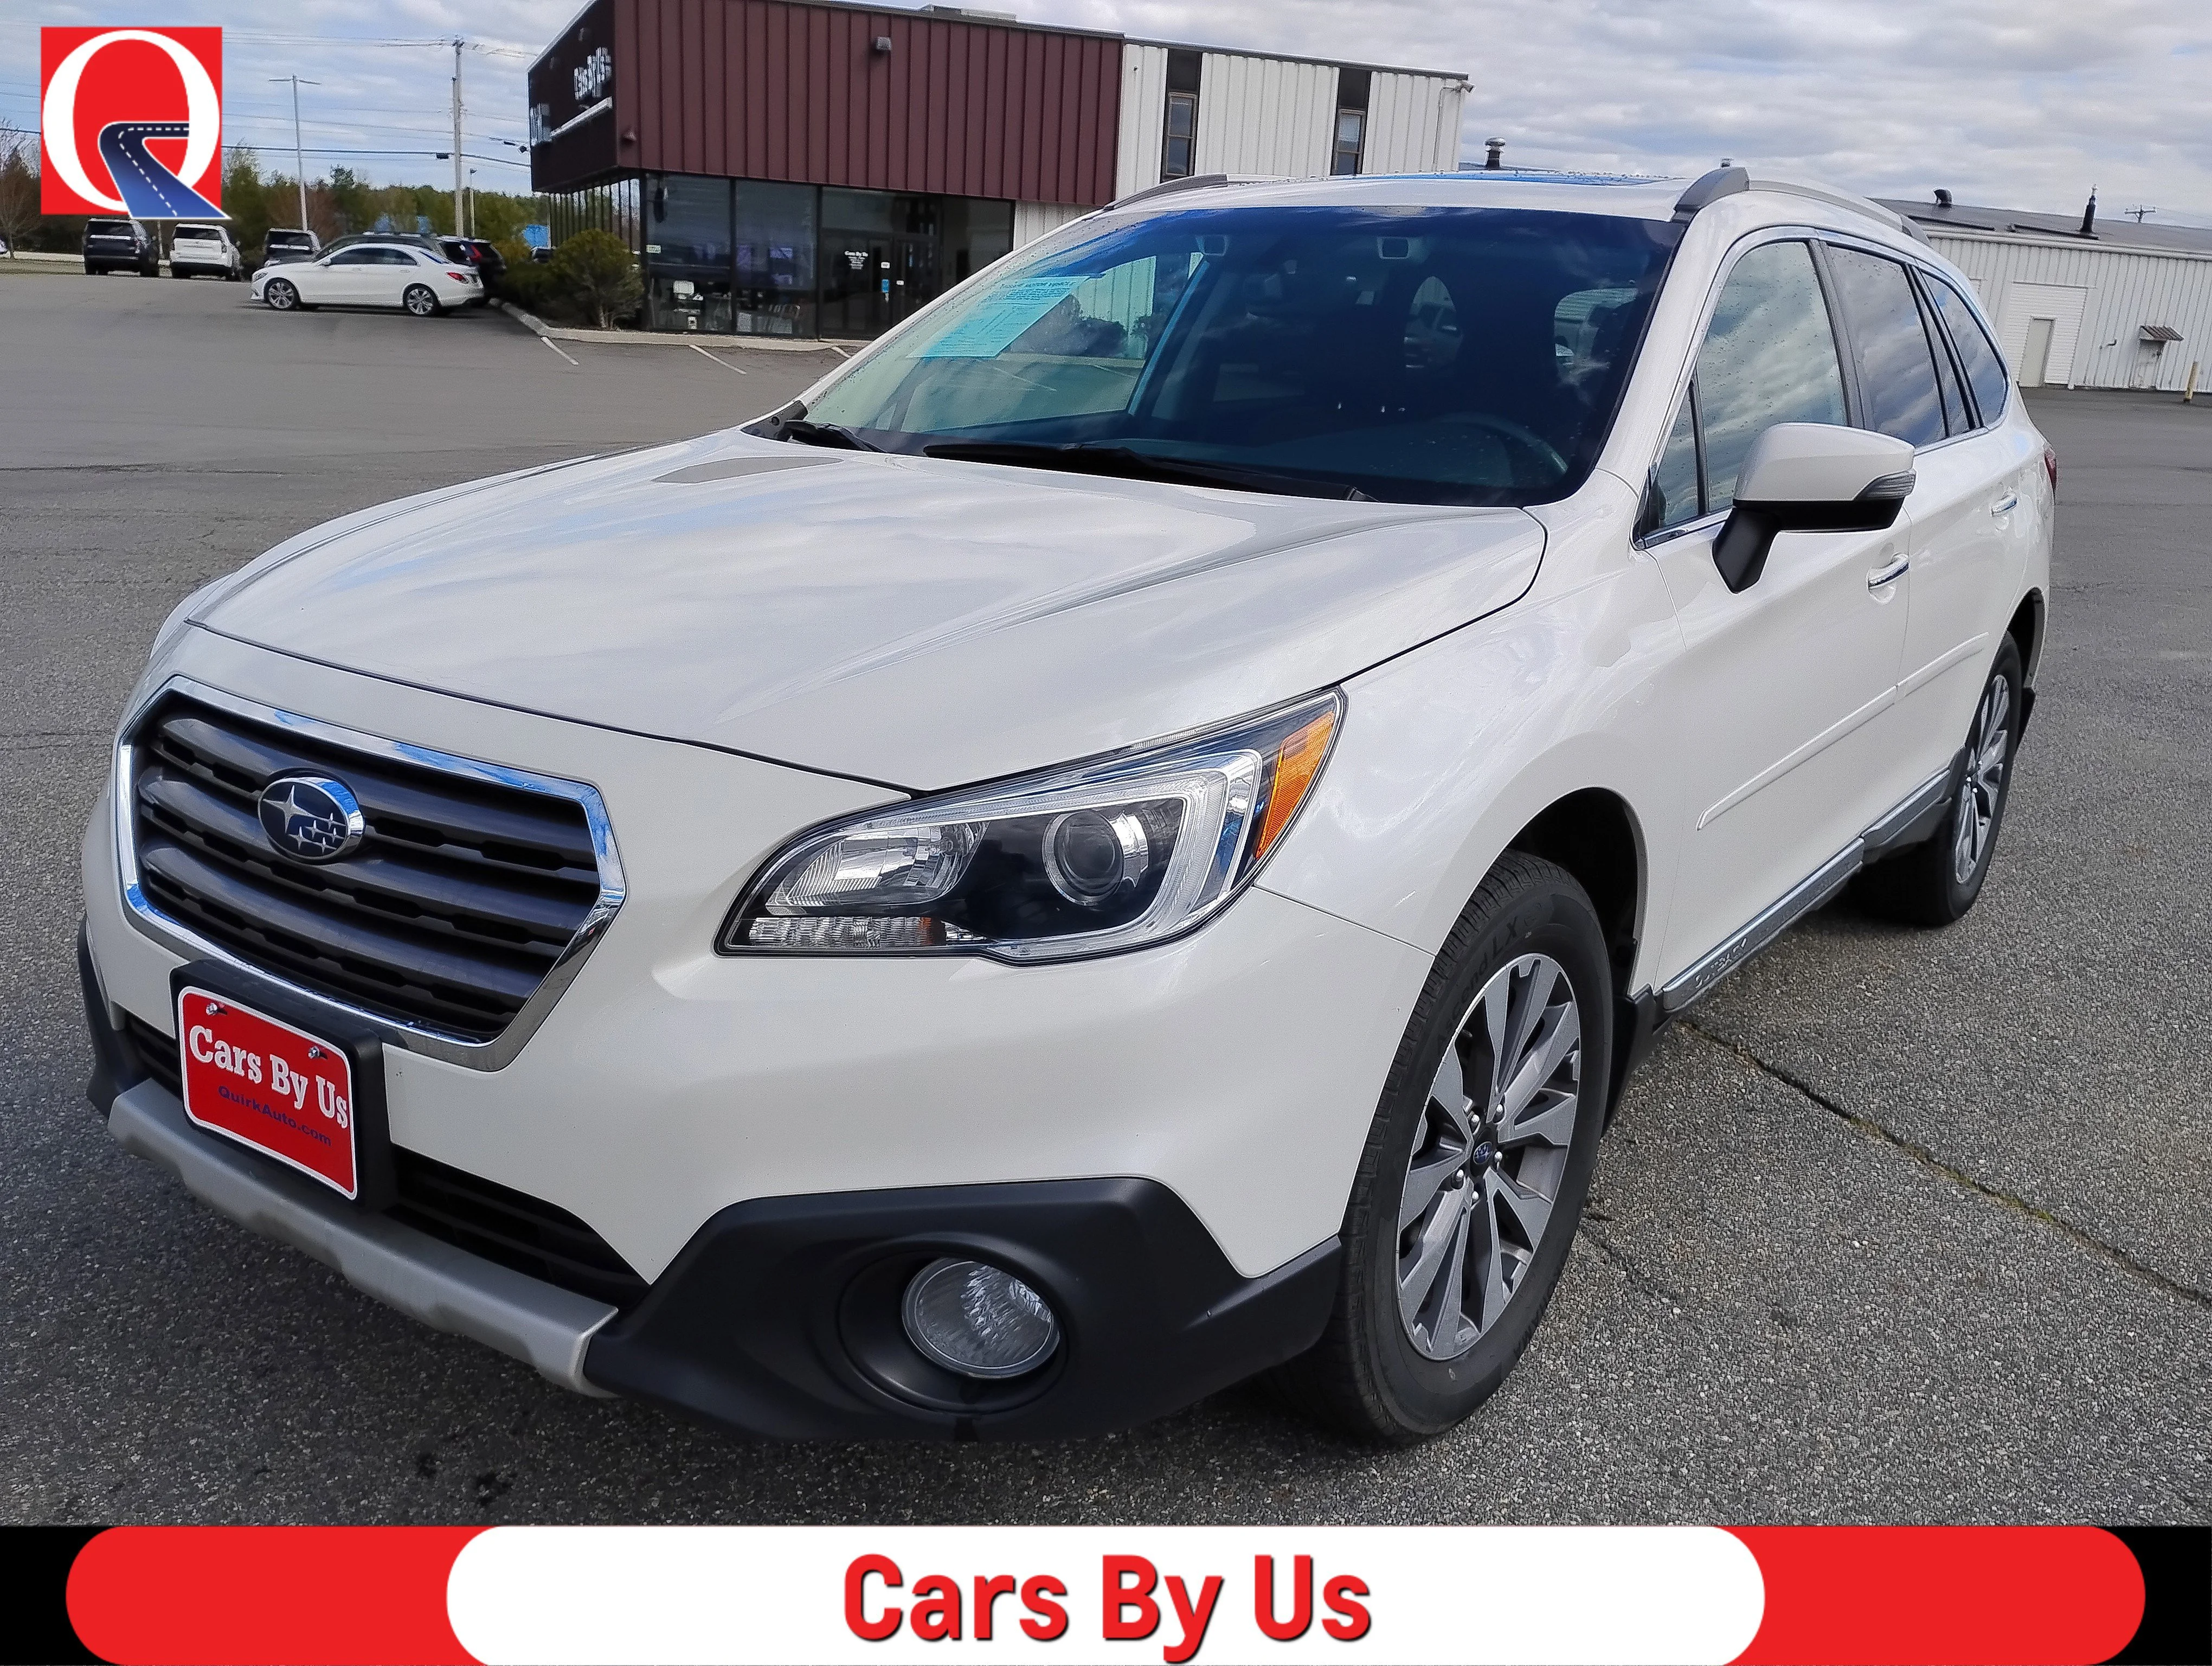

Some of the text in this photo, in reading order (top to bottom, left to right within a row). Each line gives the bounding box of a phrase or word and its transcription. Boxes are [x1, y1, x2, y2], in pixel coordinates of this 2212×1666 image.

[189, 1025, 349, 1129] Cars By Us
[217, 1085, 333, 1147] QuirkAuto.com
